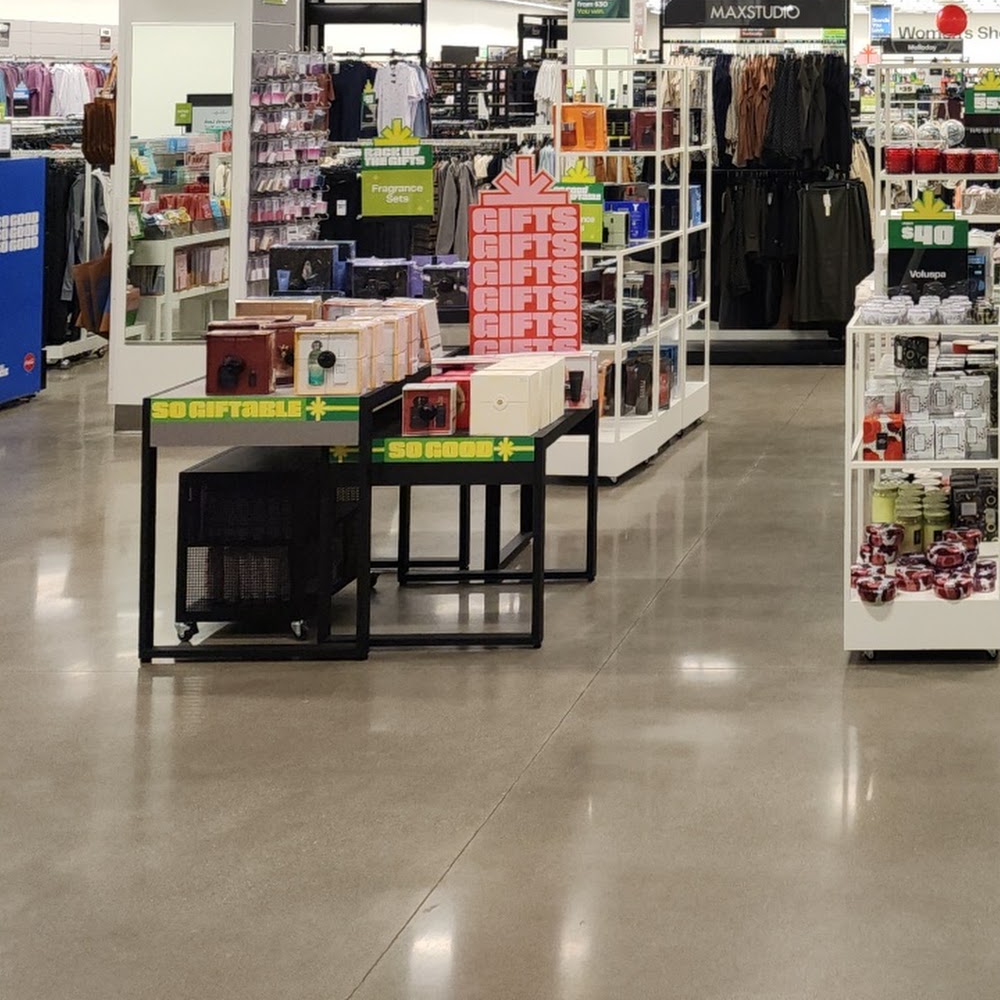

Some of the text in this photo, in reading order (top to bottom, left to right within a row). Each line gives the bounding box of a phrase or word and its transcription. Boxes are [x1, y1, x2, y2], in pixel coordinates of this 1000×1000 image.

[710, 4, 800, 20] MAXSTUDIO
[388, 156, 425, 166] GIFTS
[371, 184, 423, 195] Fragrance
[386, 194, 410, 203] Sets
[10, 211, 39, 225] GOOD
[472, 207, 578, 232] GIFTS
[10, 224, 39, 238] GOOD
[901, 225, 954, 245] $40
[9, 236, 39, 252] GOOD
[472, 233, 578, 259] GIFTS
[472, 259, 578, 285] GIFTS
[909, 269, 947, 280] Voluspa
[472, 286, 578, 312] GIFTS
[472, 312, 578, 338] GIFTS
[151, 401, 185, 419] SO
[388, 441, 493, 459] SO GOOD
